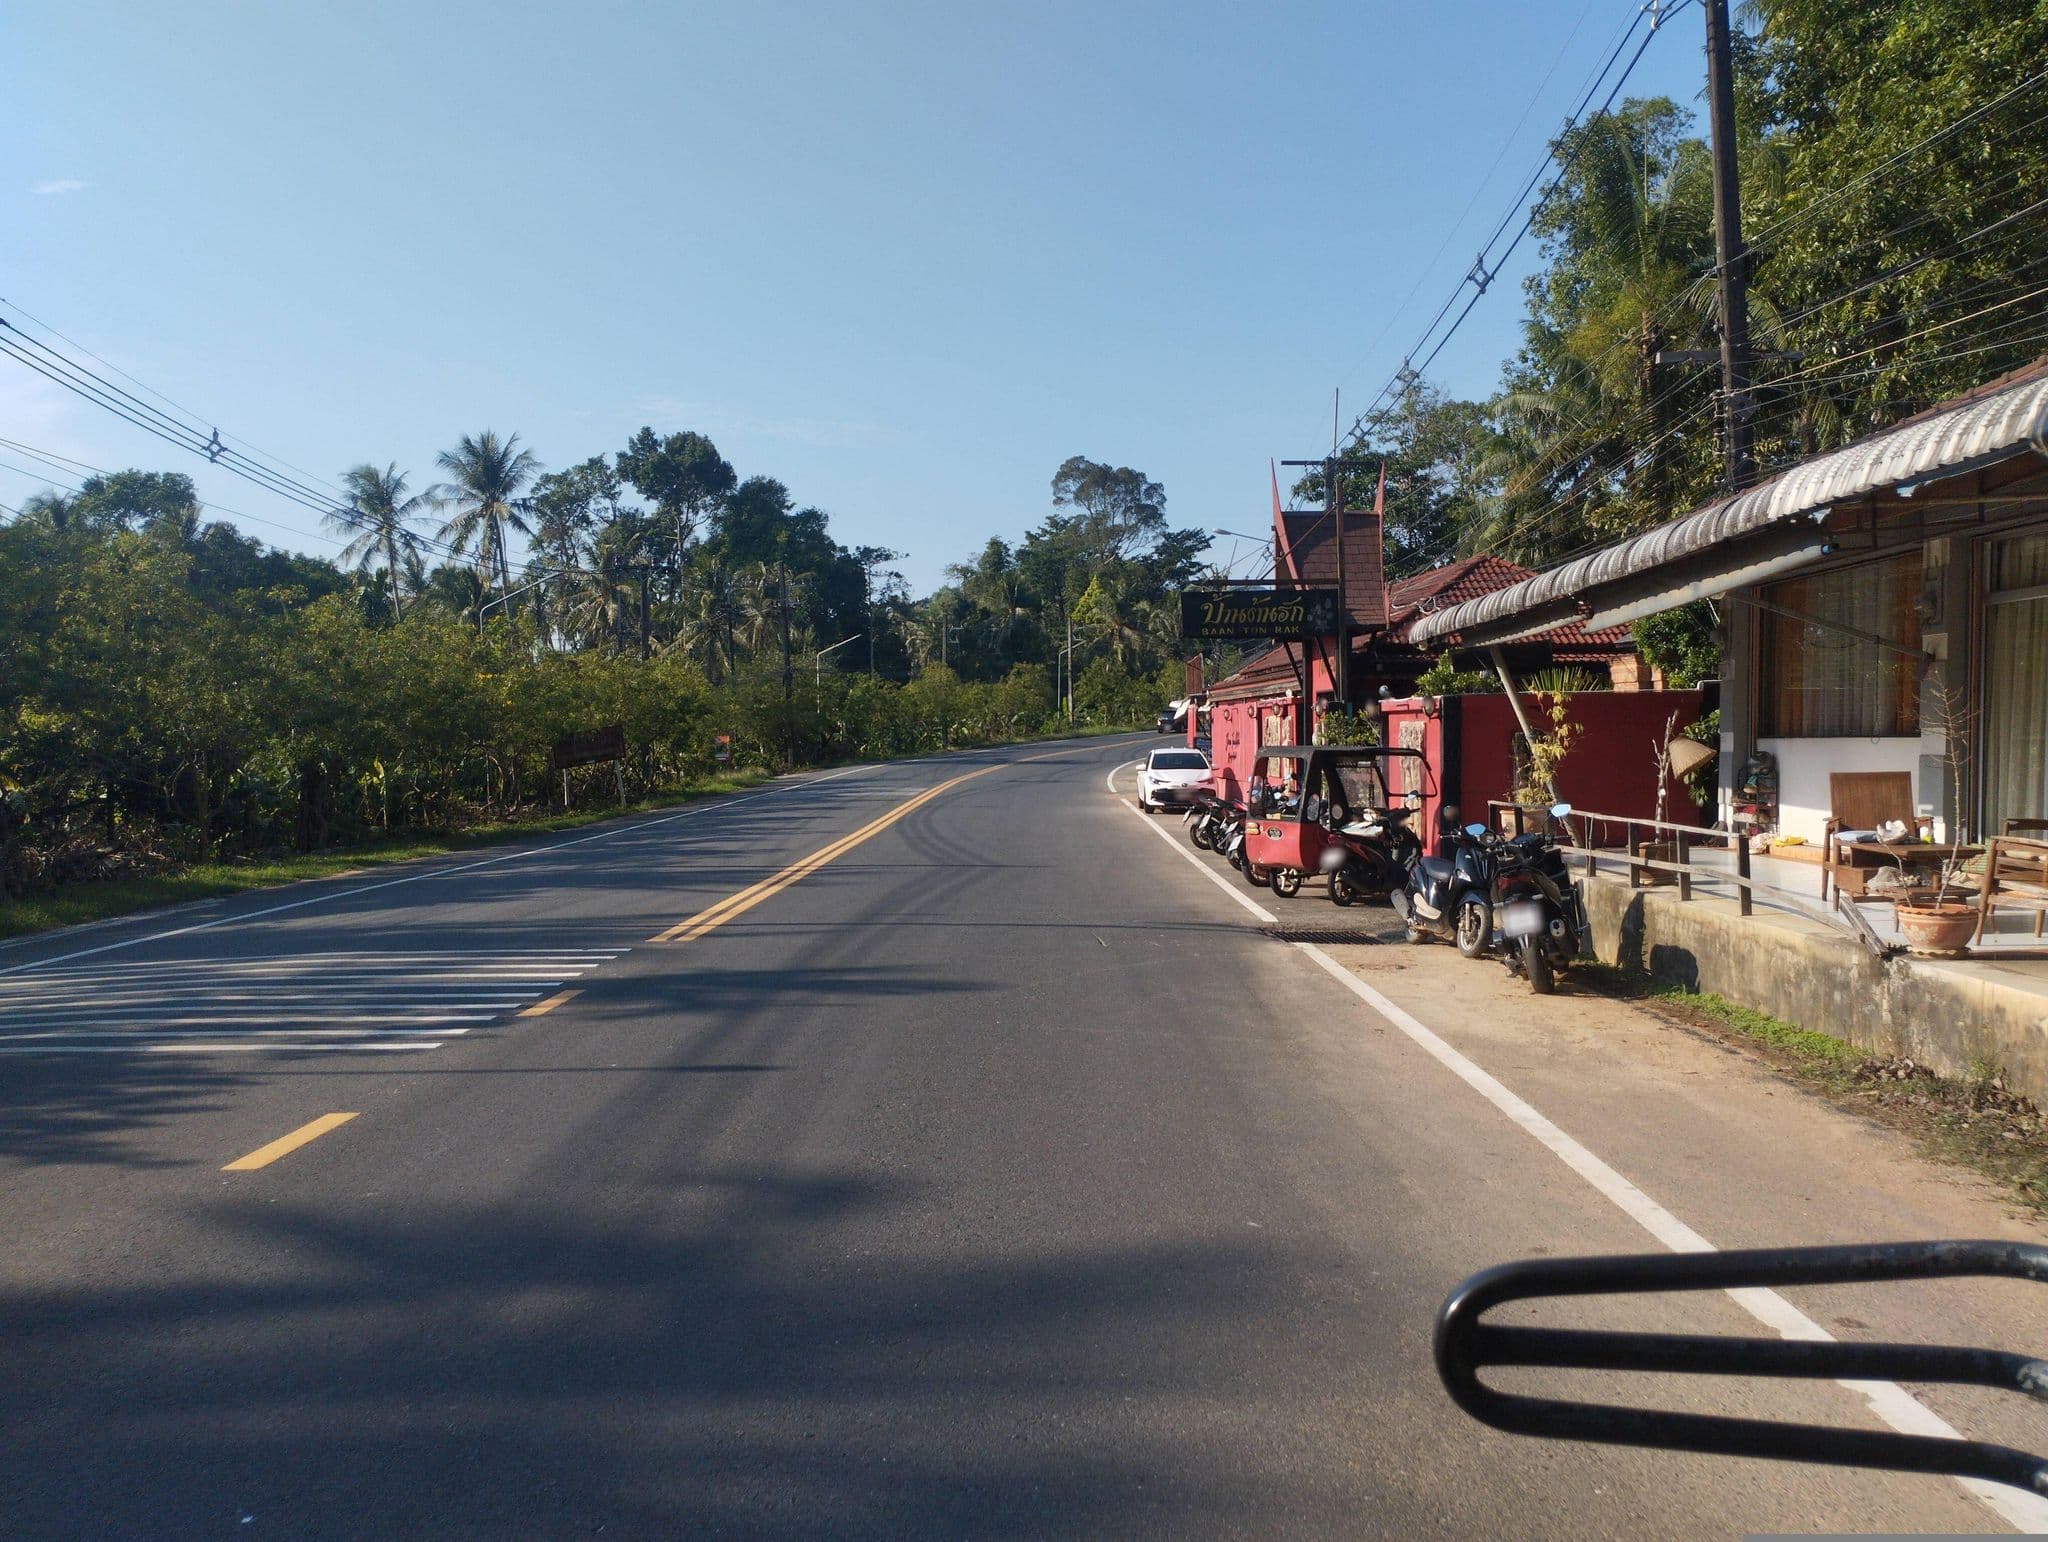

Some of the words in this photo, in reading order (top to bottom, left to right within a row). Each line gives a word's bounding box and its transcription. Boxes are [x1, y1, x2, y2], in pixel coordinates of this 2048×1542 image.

[1200, 593, 1304, 624] บ้านต้นรัก
[1201, 627, 1234, 636] BAAN
[1243, 626, 1267, 635] TON
[1275, 625, 1300, 635] RAK
